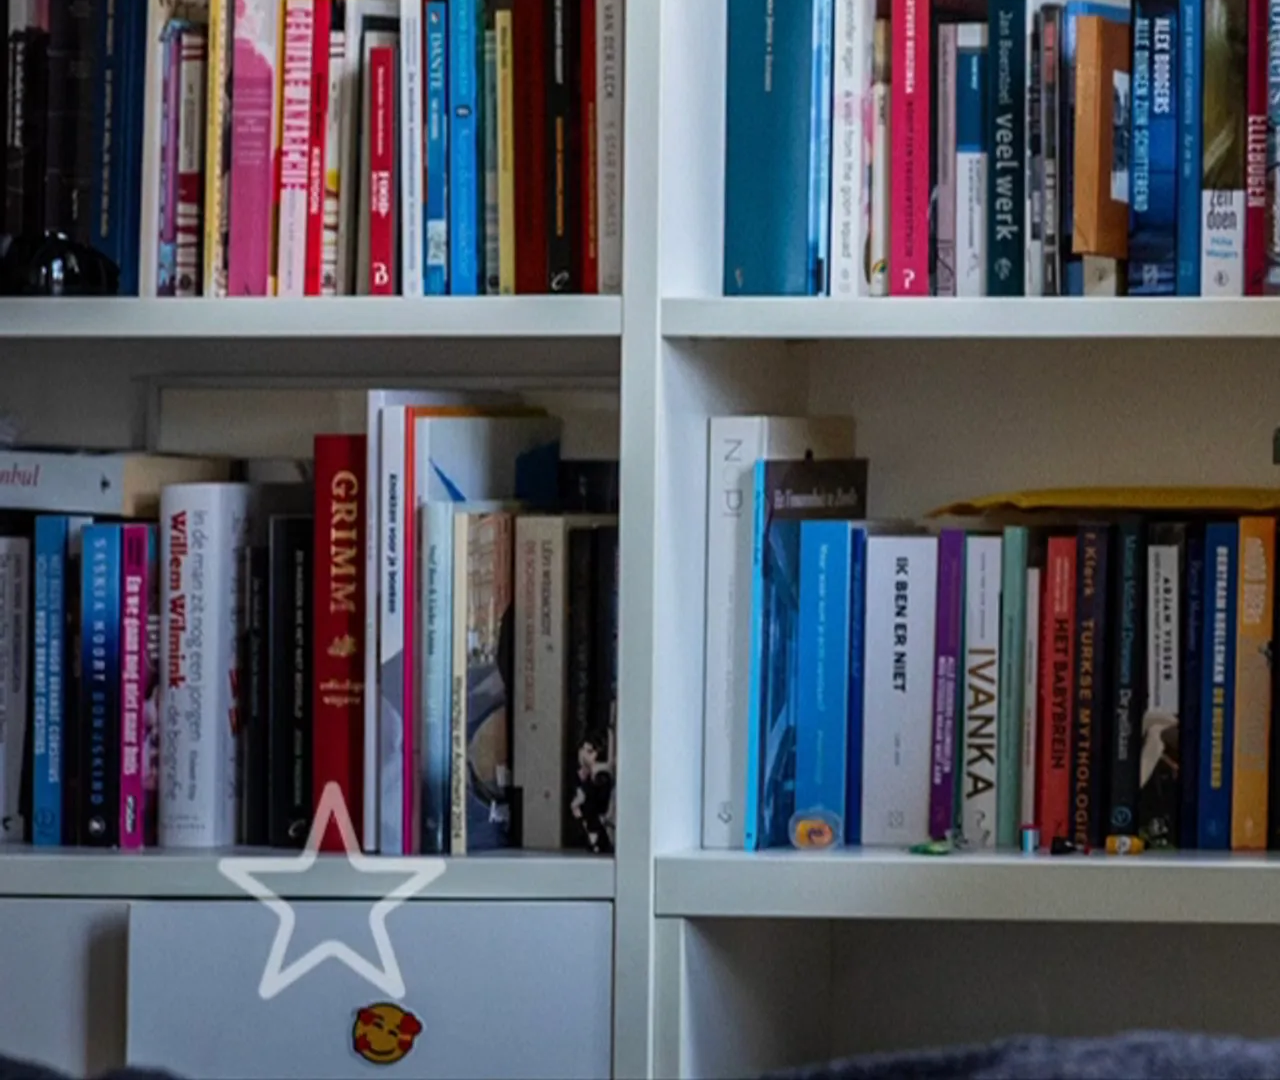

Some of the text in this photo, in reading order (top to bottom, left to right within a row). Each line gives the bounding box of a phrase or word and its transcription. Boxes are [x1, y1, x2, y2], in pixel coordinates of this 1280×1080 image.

[429, 32, 443, 90] DANTE
[1154, 18, 1171, 113] ALEX BOOGERS
[996, 113, 1018, 169] veel
[996, 176, 1018, 240] werk
[168, 511, 186, 689] Willem Wilmink
[328, 470, 359, 615] GRIMM
[892, 557, 908, 693] IK BEN ER NIET
[966, 648, 996, 800] IVANKA
[1051, 618, 1068, 769] HET BABYBREIN
